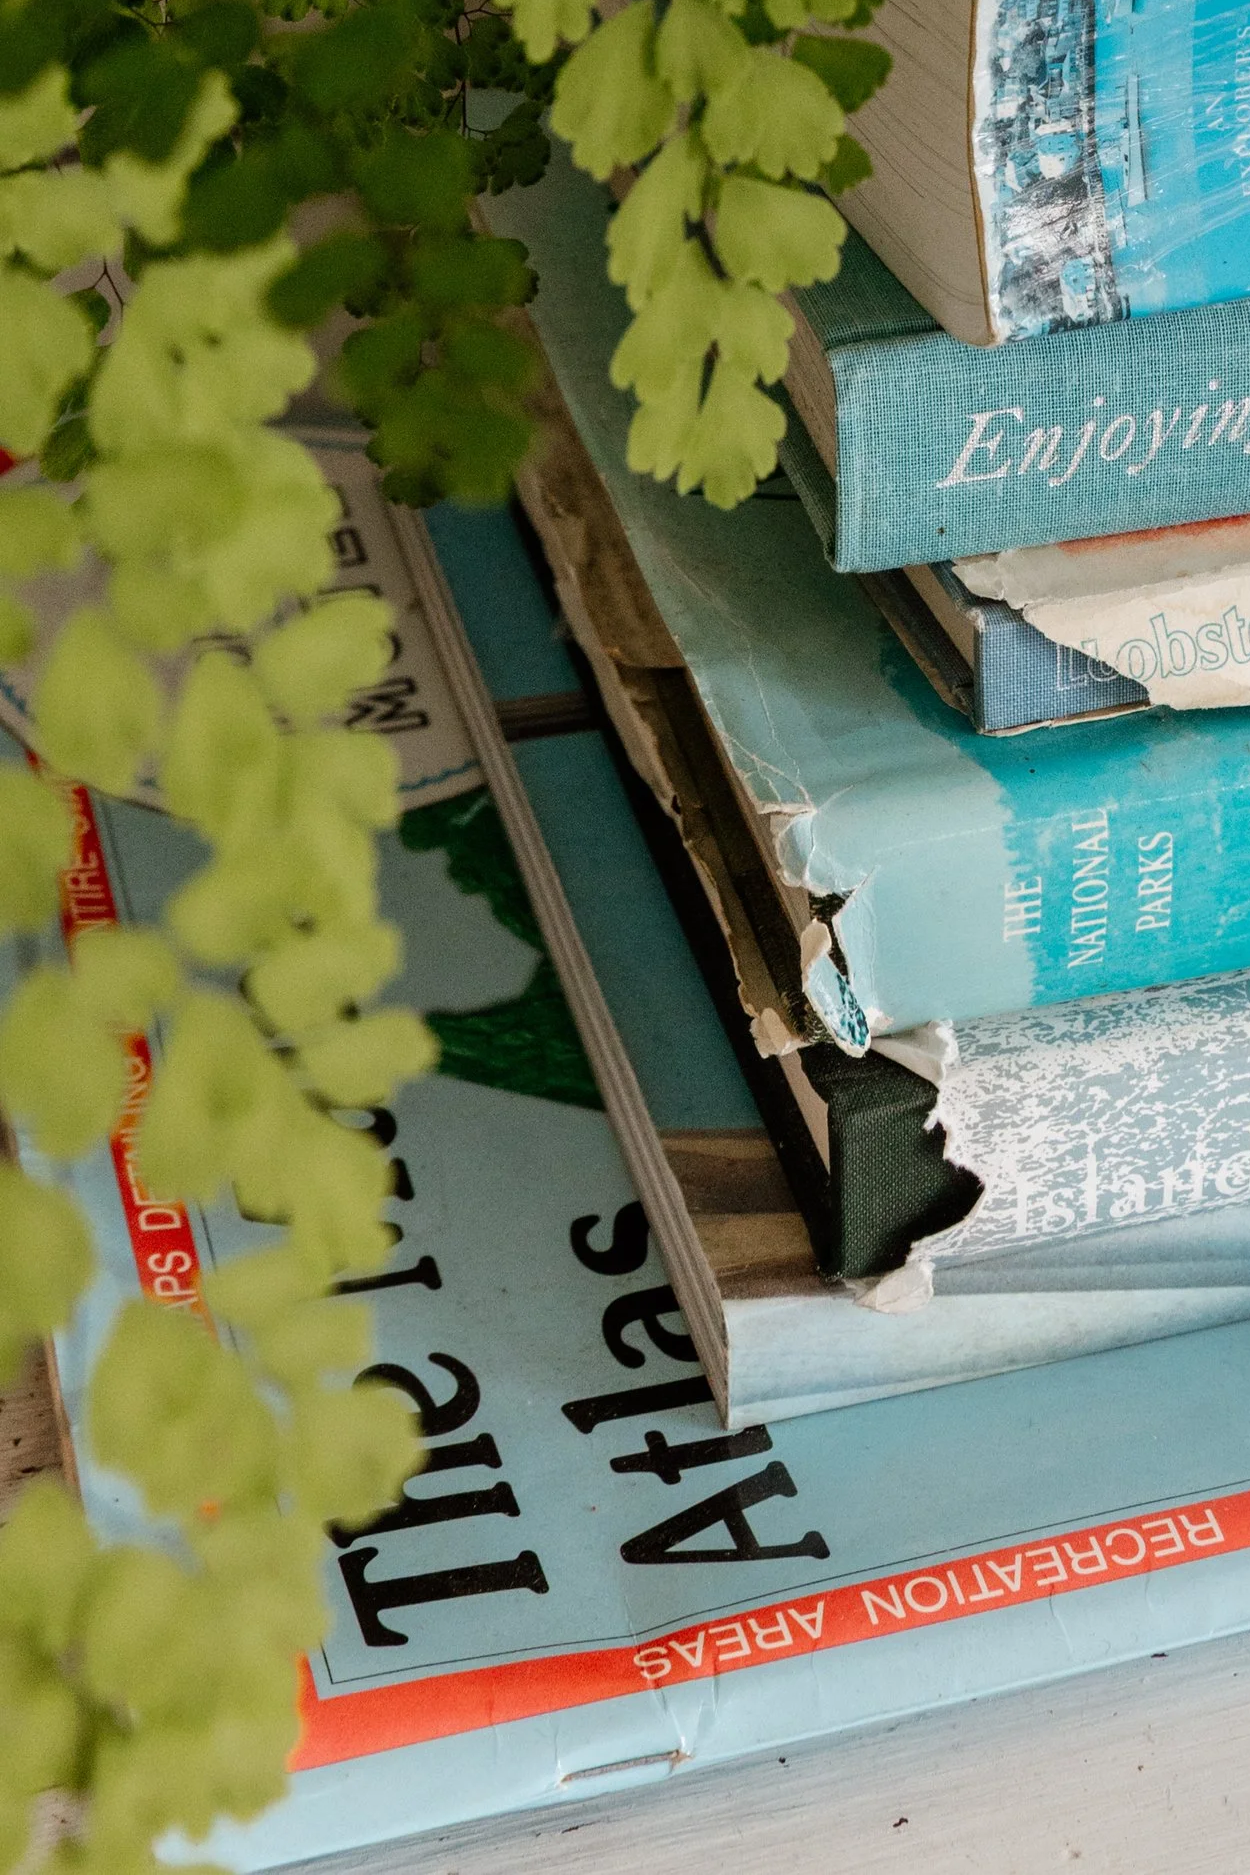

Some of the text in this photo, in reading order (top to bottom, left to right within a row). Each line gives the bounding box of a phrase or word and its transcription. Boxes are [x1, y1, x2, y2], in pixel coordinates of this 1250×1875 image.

[1002, 875, 1043, 943] THE
[1066, 805, 1112, 969] NATIONAL
[1135, 830, 1174, 933] PARKS
[561, 1200, 831, 1565] Atlas
[860, 1508, 1226, 1626] RECREATION
[633, 1600, 826, 1681] AREAS
